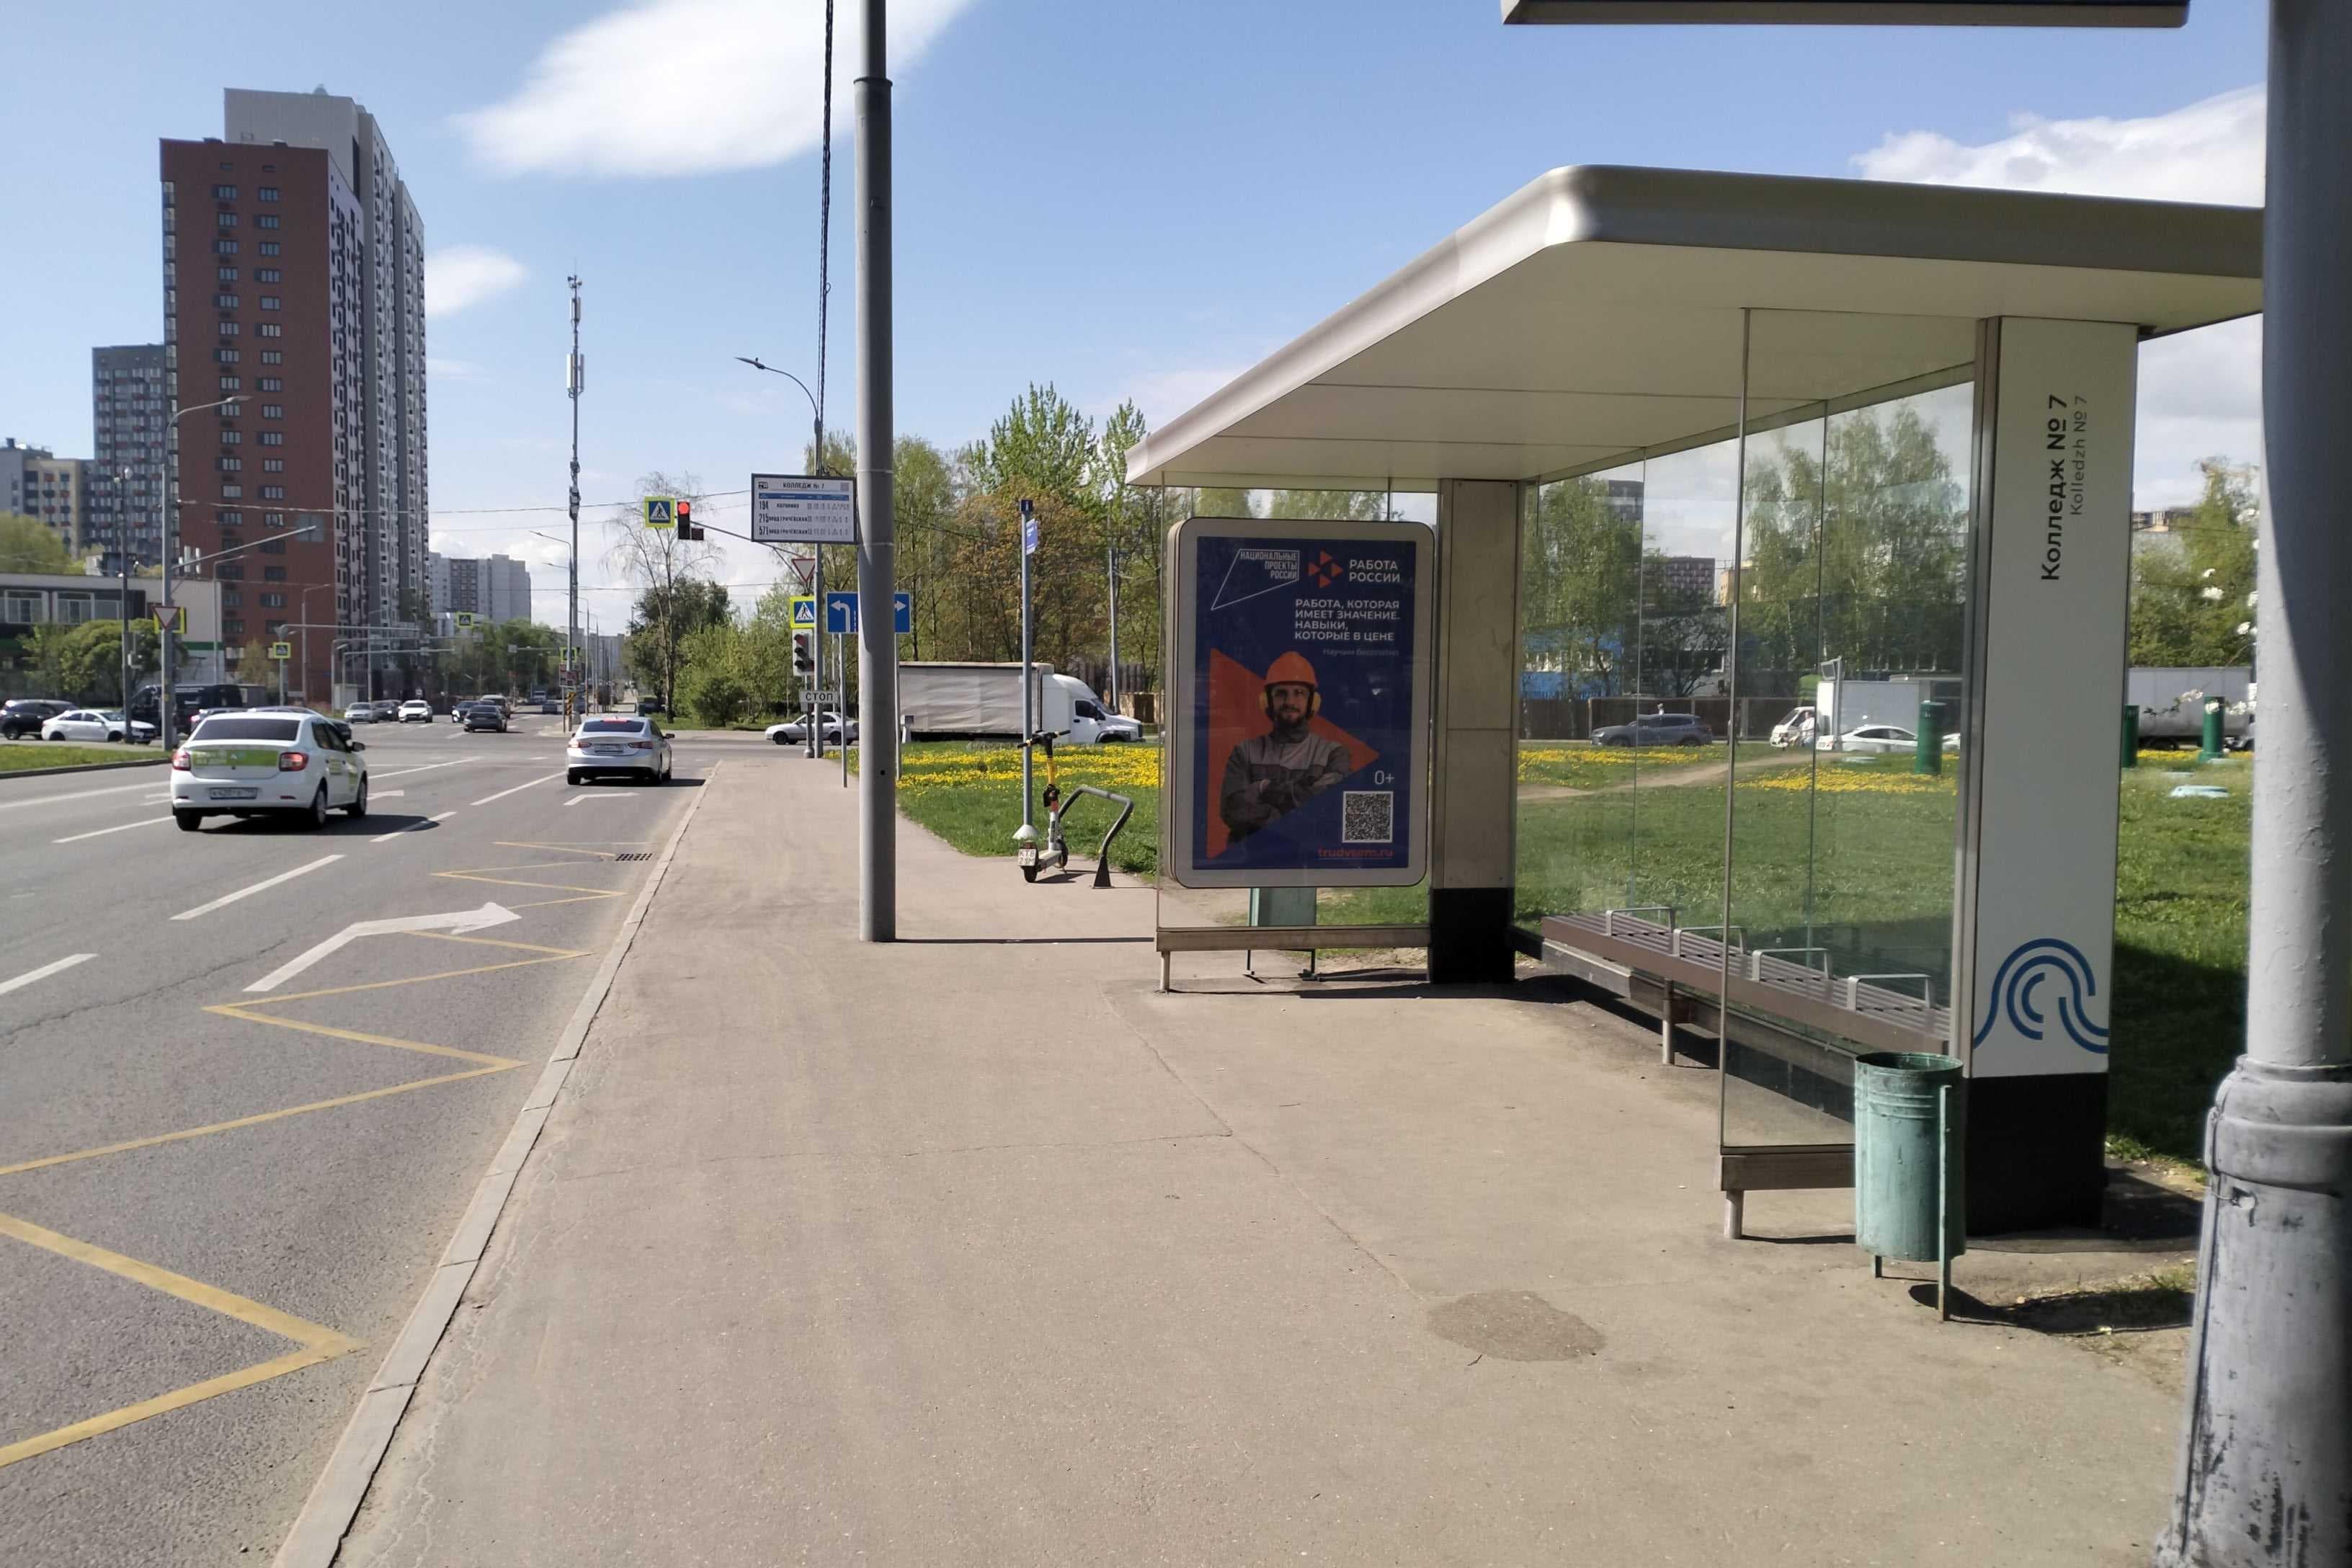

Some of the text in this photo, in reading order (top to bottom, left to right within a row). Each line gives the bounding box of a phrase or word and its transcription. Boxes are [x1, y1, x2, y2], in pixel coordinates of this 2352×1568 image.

[2070, 396, 2088, 515] Kolledzh № 7
[2041, 394, 2067, 580] Колледж № 7
[759, 512, 769, 523] 215
[759, 525, 768, 535] 571
[1240, 551, 1298, 561] НАЦИОНАЛЬНЫЕ
[1265, 561, 1298, 570] ПРОЕКТЫ
[1349, 559, 1399, 571] РАБОТА
[1270, 570, 1298, 580] РОССИИ
[1349, 571, 1401, 583] РОССИИ
[1295, 599, 1400, 610] РАБОТА, КОТОРАЯ
[1295, 610, 1402, 620] ИМЕЕТ ЗНАЧЕНИЕ.
[1295, 620, 1349, 632] НАВЫКИ,
[1294, 631, 1395, 642] КОТОРЫЕ В ЦЕНЕ
[806, 692, 833, 701] СТОП
[1374, 770, 1395, 785] 0+
